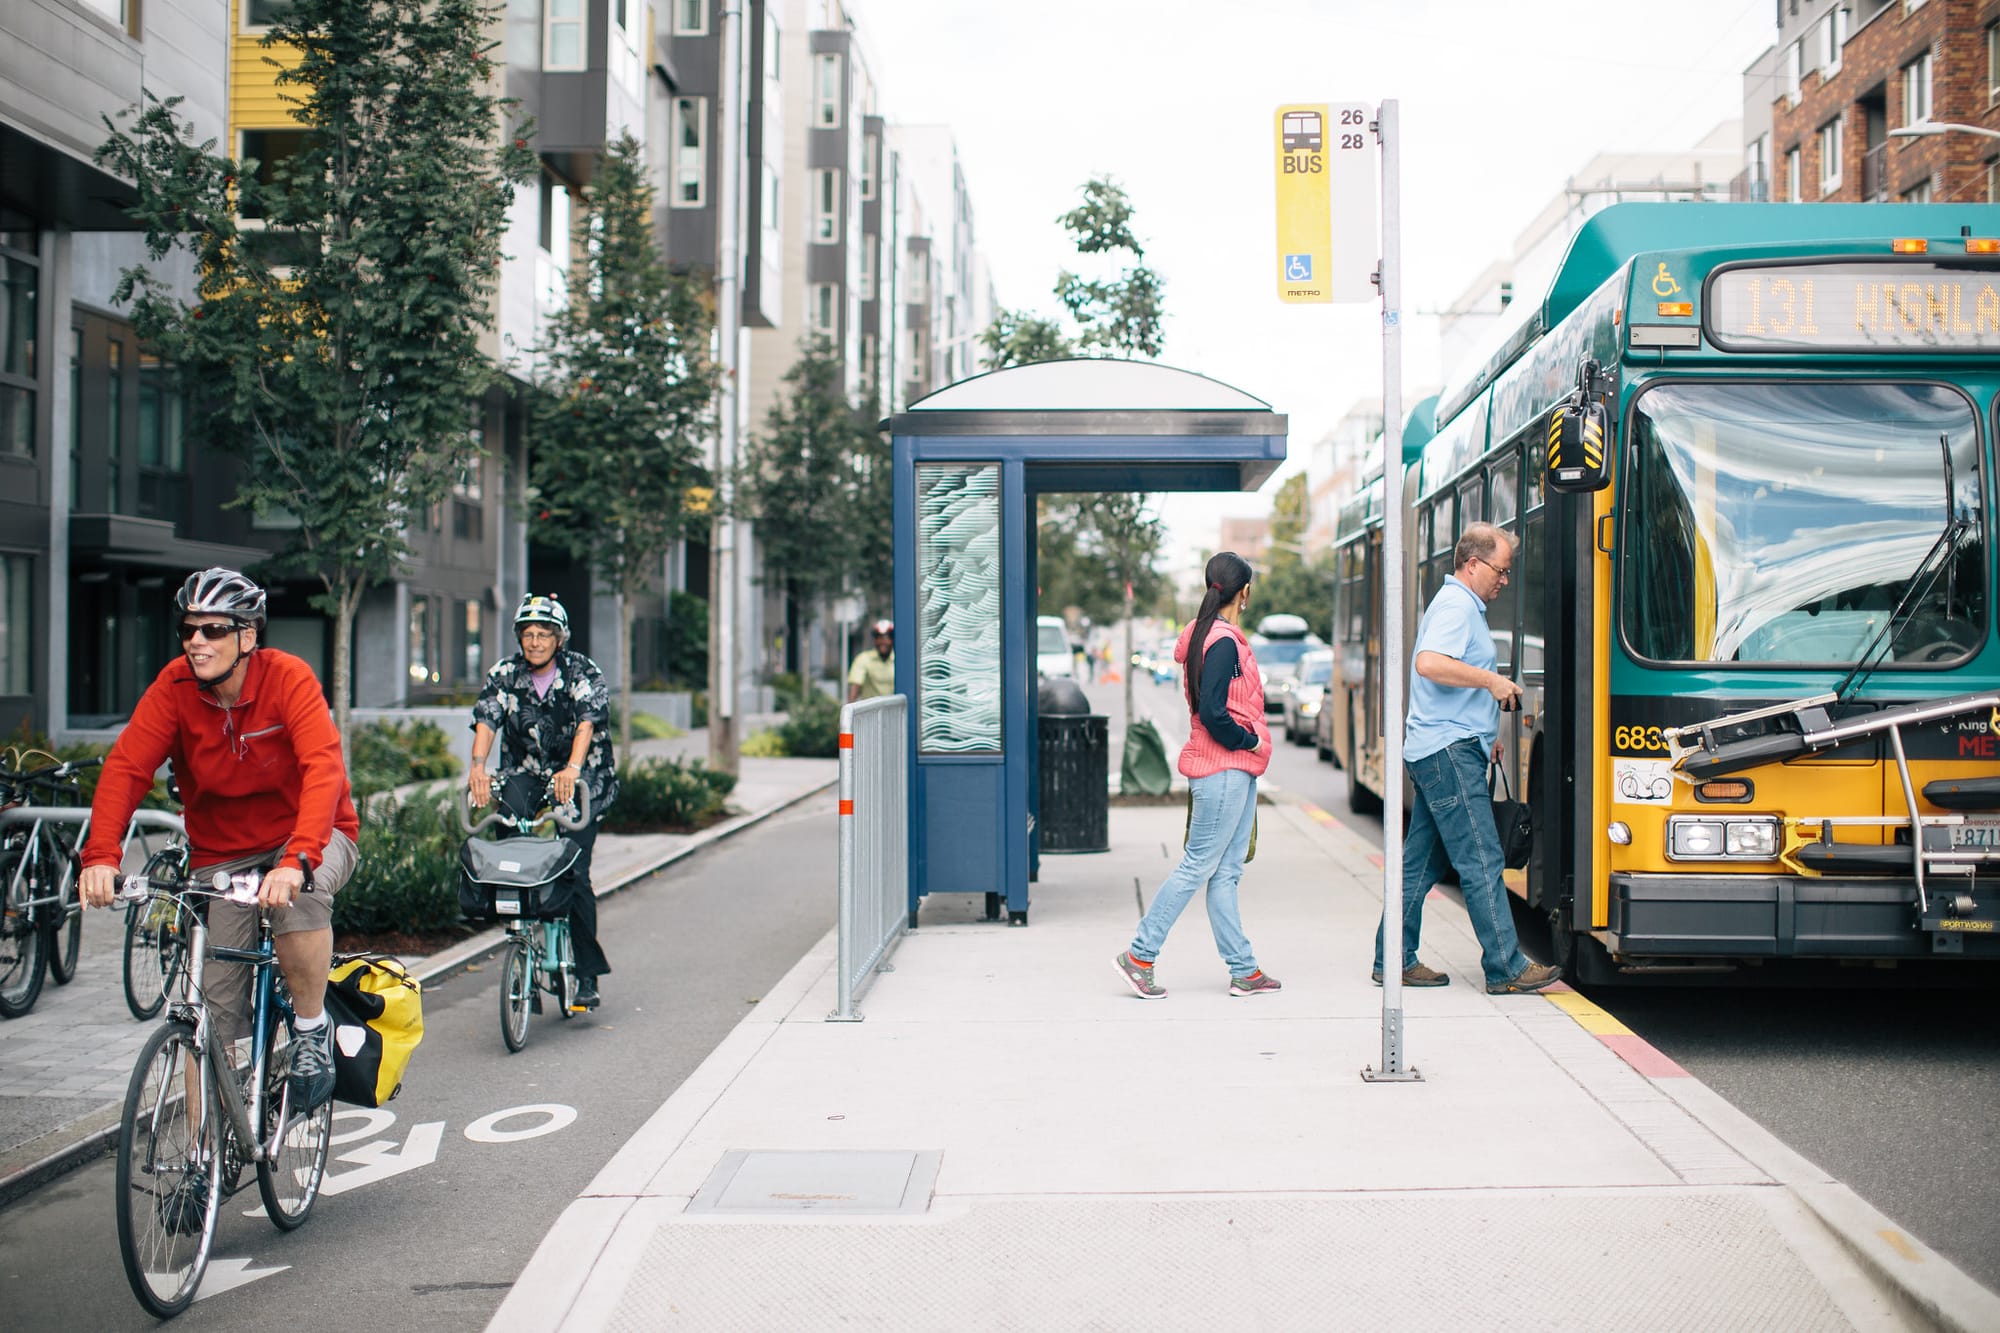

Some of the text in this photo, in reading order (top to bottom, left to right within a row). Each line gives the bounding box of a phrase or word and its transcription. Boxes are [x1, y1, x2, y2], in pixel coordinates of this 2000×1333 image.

[1341, 109, 1364, 125] 26
[1341, 134, 1364, 149] 28
[1283, 155, 1322, 174] BUS
[1746, 279, 2000, 335] 131 HIGHLA
